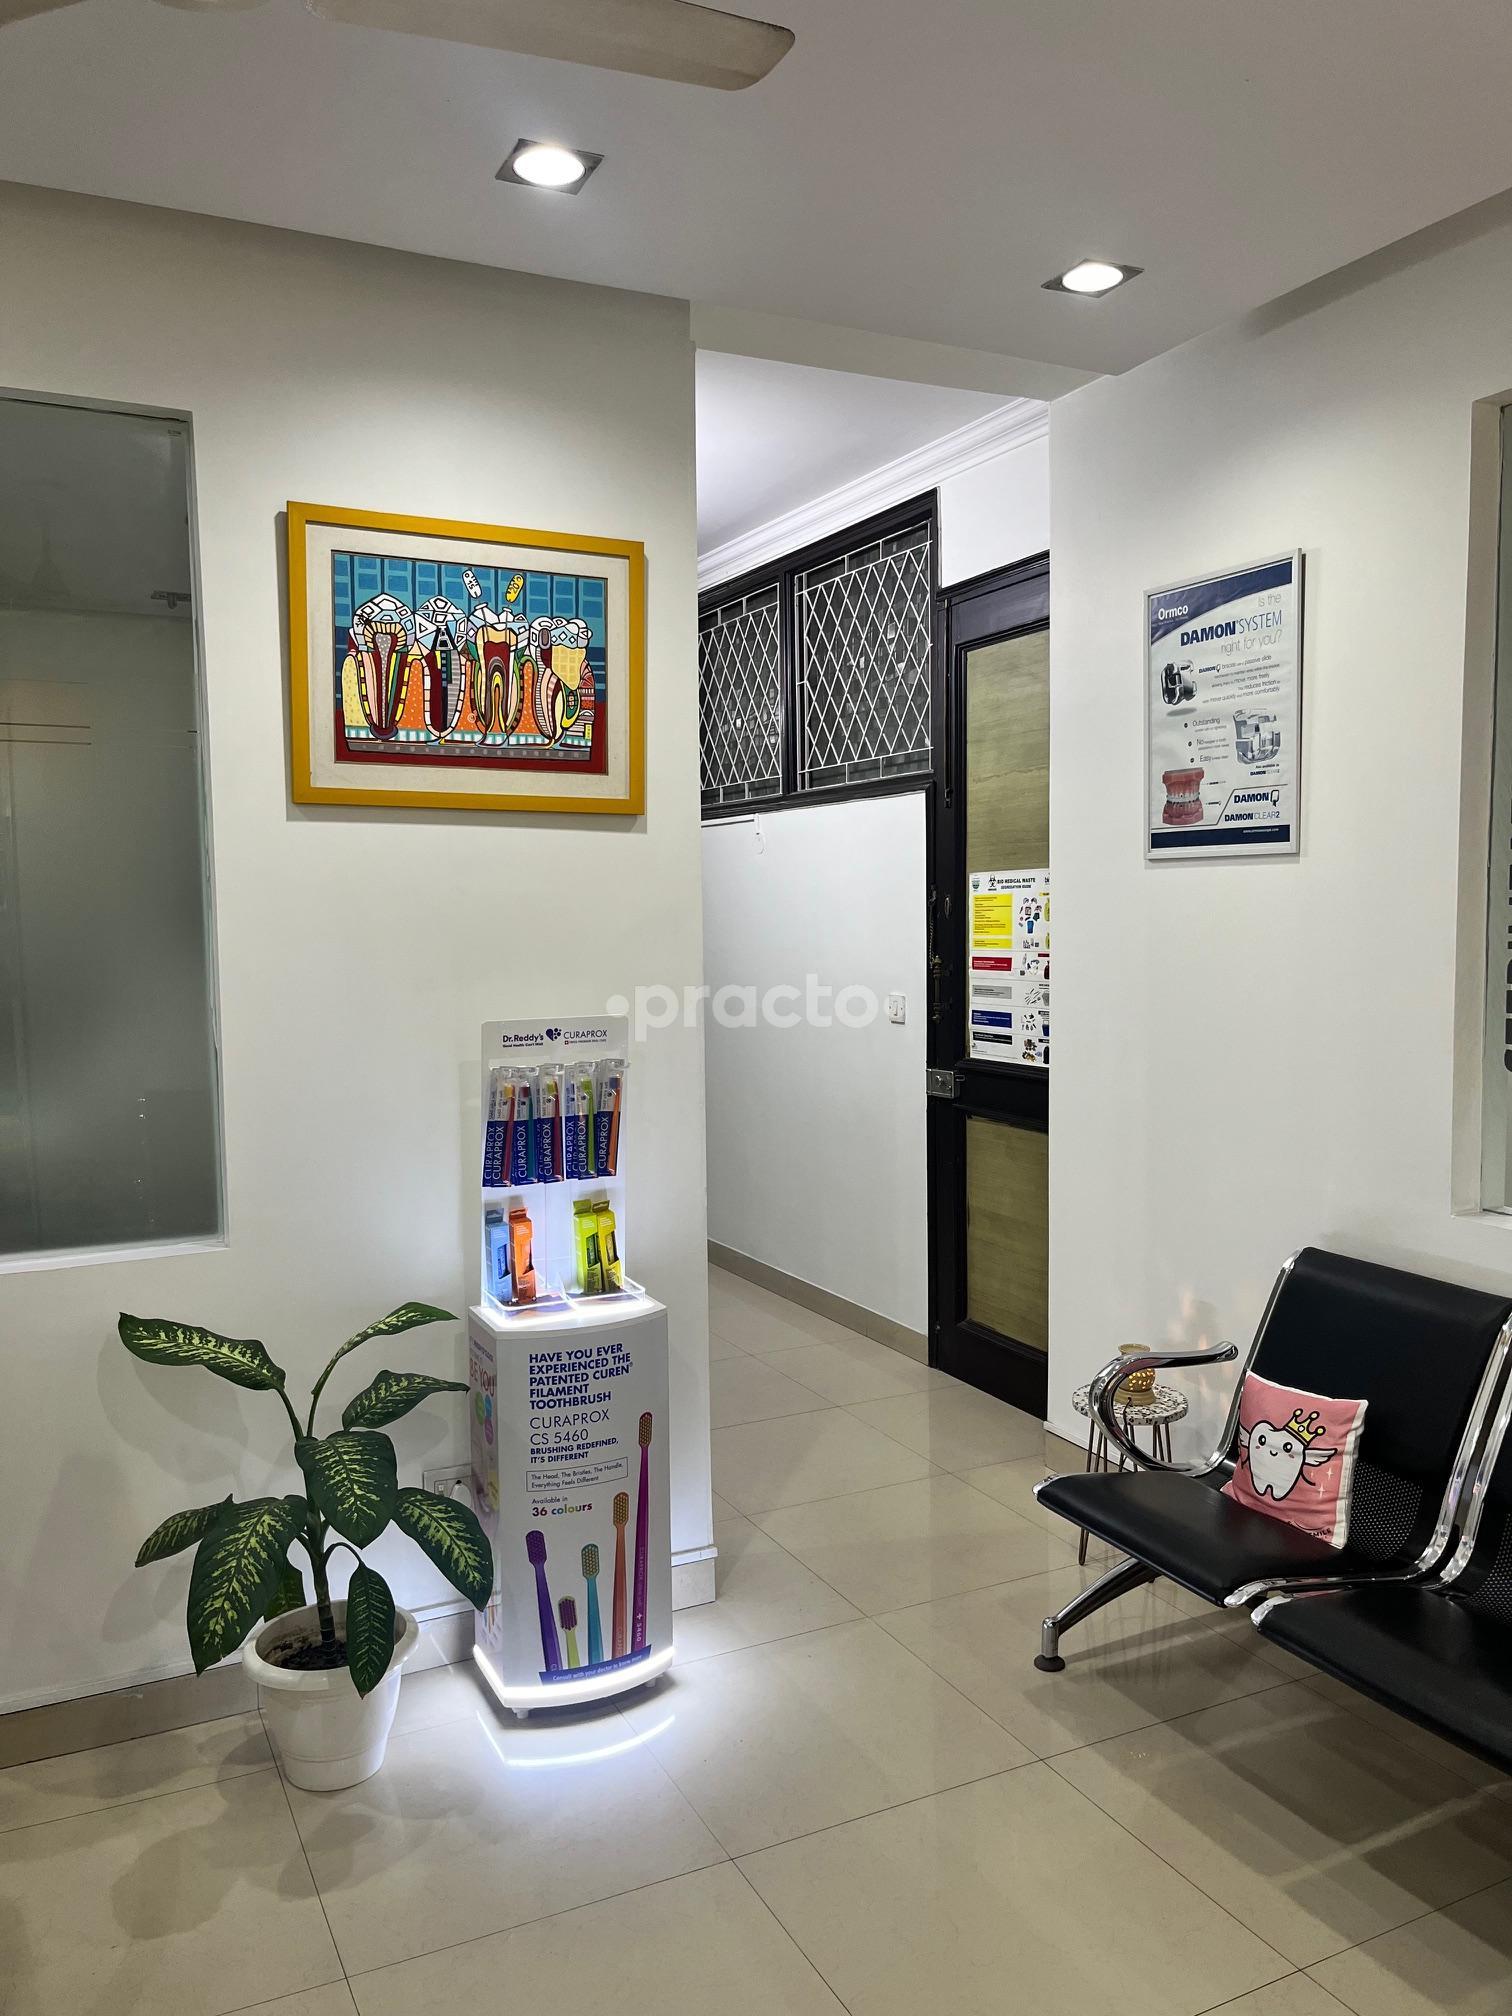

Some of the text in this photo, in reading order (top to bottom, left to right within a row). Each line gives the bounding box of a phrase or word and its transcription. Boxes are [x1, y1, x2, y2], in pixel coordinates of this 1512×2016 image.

[1158, 605, 1188, 620] Ormco
[1180, 620, 1236, 646] DAMON
[1243, 637, 1255, 650] for
[1234, 792, 1269, 803] DAMON
[503, 1033, 544, 1043] Dr.Reddy's
[563, 1029, 607, 1039] CURAPROX
[543, 1123, 553, 1176] CURAPROX
[578, 1120, 587, 1172] CURAPROX
[598, 1117, 609, 1169] CURAPROX
[493, 1126, 504, 1180] CURAPROX
[517, 1126, 527, 1178] CURAPROX
[529, 1343, 623, 1363] HAVE YOU EVER
[529, 1353, 631, 1375] EXPERIENCED THE
[529, 1373, 589, 1386] PATENTED
[530, 1383, 589, 1398] FILAMENT
[530, 1391, 612, 1410] TOOTHBRUSH
[530, 1409, 610, 1430] CURAPROX
[530, 1428, 589, 1446] CS 5460
[530, 1444, 574, 1455] BRUSHING
[530, 1451, 589, 1464] IT'S DIFFERENT
[531, 1481, 561, 1489] Everything
[576, 1476, 599, 1484] Different
[532, 1503, 593, 1517] 36 colours
